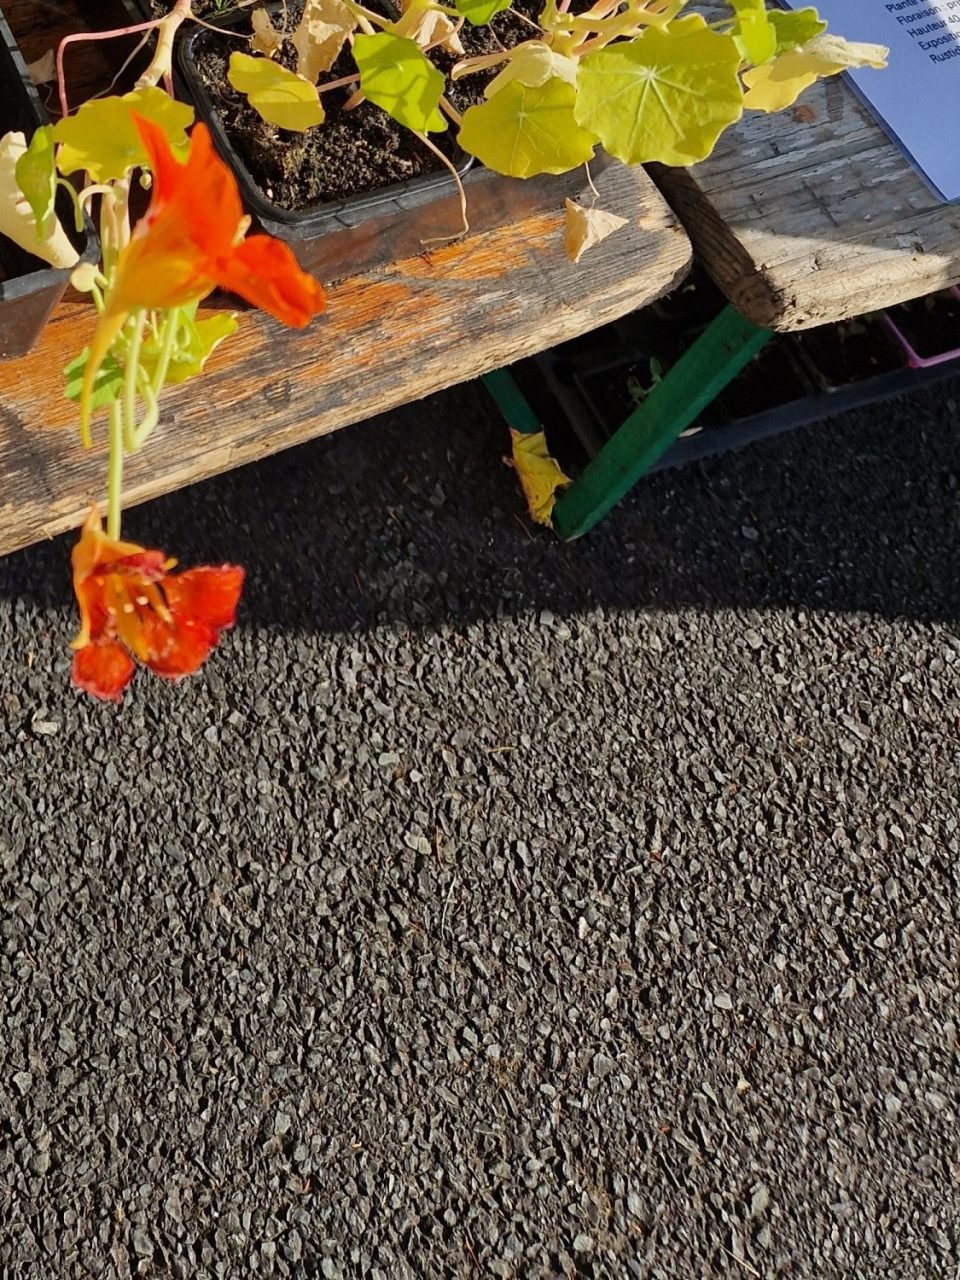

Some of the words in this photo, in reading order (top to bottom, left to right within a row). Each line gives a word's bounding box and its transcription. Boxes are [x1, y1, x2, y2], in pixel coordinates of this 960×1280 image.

[896, 6, 942, 25] Floraison
[907, 20, 947, 38] Hauteur
[929, 44, 960, 64] Rustic
